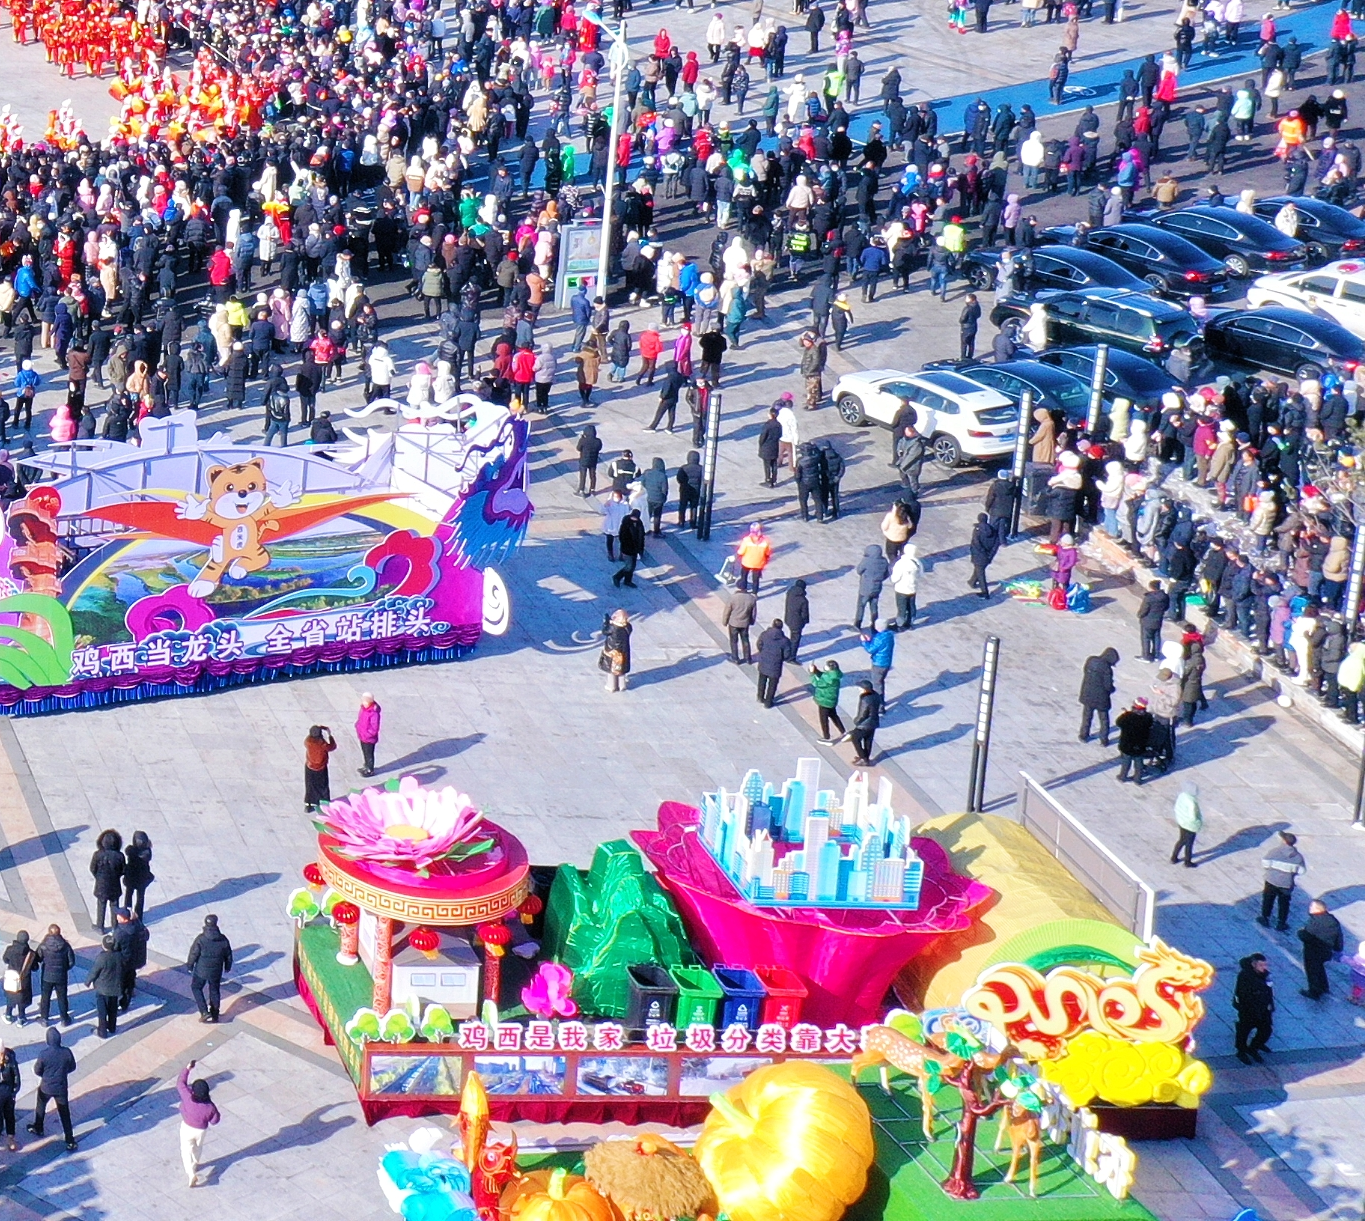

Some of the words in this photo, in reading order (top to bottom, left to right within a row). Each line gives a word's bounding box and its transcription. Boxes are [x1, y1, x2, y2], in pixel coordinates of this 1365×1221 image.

[70, 628, 246, 677] 鸡西当龙头
[265, 605, 433, 656] 全省站排头
[460, 1022, 623, 1053] 鸡西是我家
[647, 1022, 871, 1053] 垃圾分类靠大
